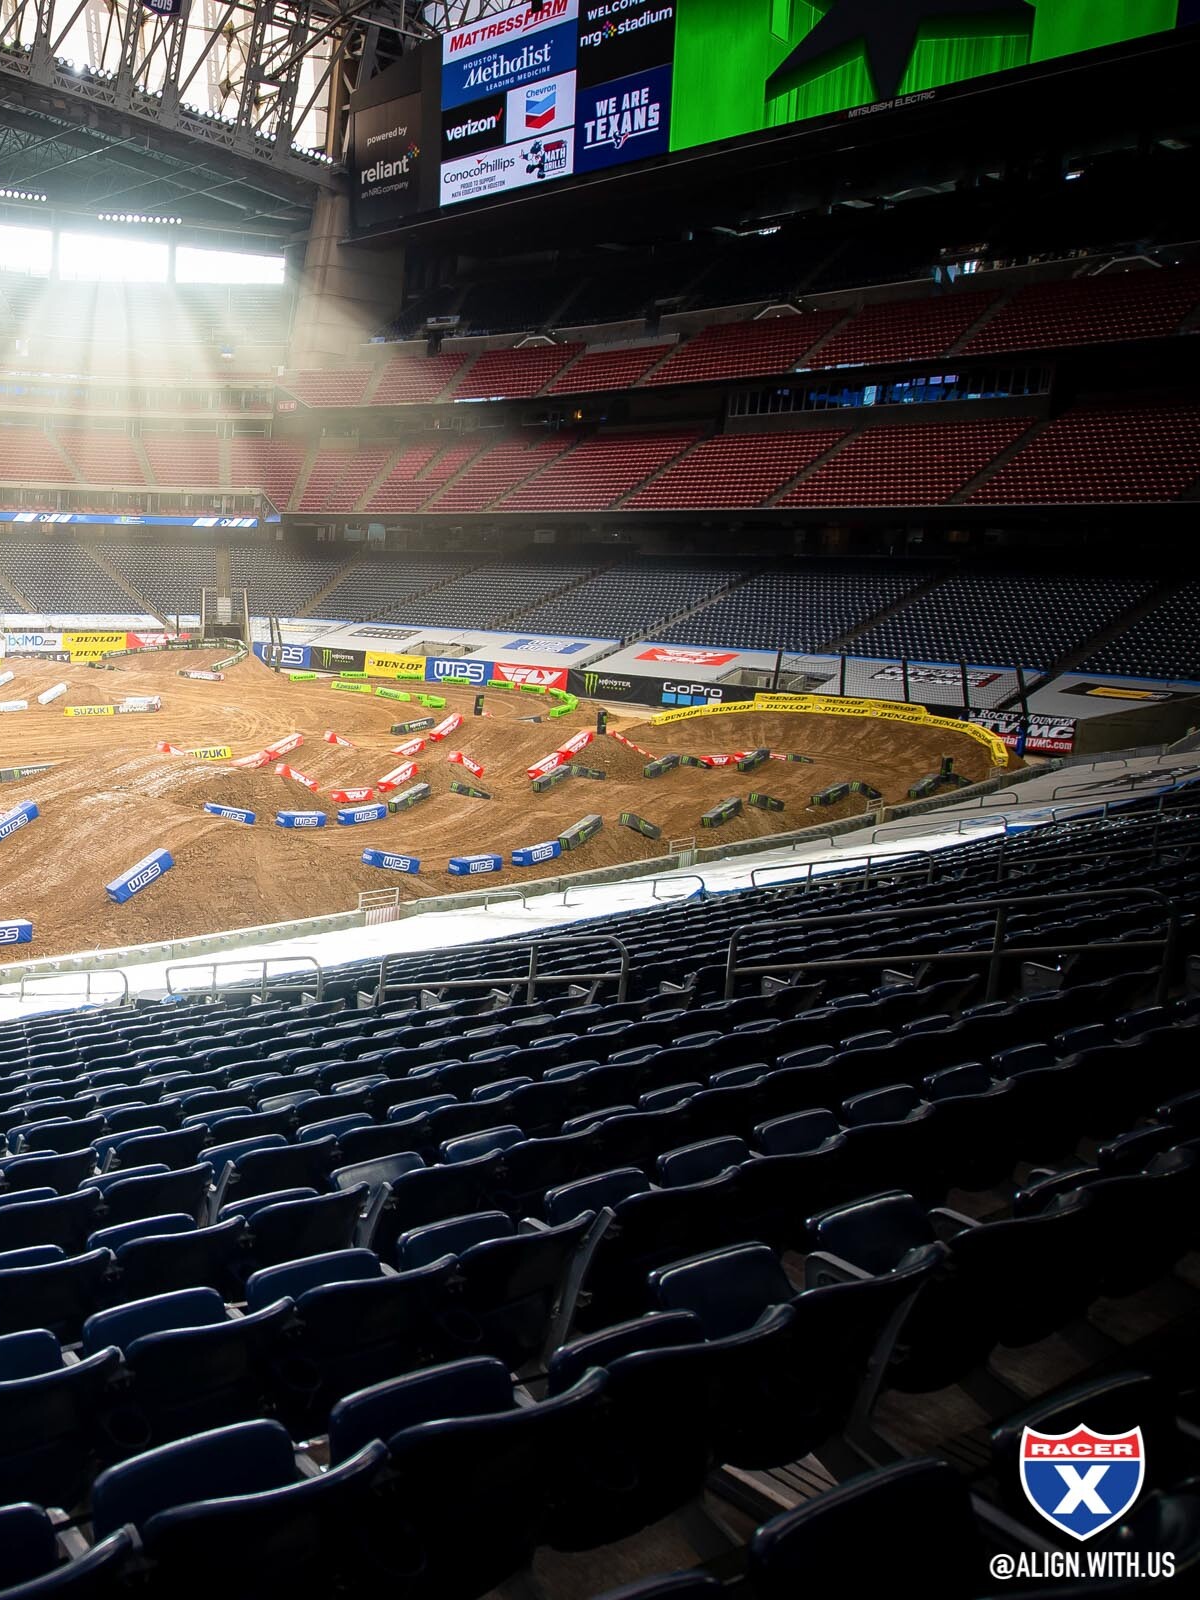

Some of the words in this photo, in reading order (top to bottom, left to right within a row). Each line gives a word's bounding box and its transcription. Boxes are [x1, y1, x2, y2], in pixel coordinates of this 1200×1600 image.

[587, 0, 646, 21] WELCOM
[580, 31, 602, 47] nrg
[617, 7, 673, 35] stadium
[463, 53, 498, 71] HOUSTON
[463, 43, 552, 89] Methodist
[486, 76, 515, 92] LEADING
[517, 65, 551, 82] MEDICINE
[525, 83, 557, 99] Chevron
[595, 97, 617, 118] WE
[621, 86, 650, 111] ARE
[848, 100, 893, 119] MITSUBISHI
[894, 90, 936, 107] ELECTRIC
[446, 114, 496, 141] verizon
[584, 103, 660, 144] TEXANS
[367, 129, 398, 147] powered
[360, 155, 410, 185] reliant
[443, 156, 515, 184] ConocoPhillips
[376, 660, 423, 671] DUNLOP
[433, 660, 484, 682] WPS
[599, 678, 631, 688] MONSTER
[662, 682, 723, 698] GoPro
[73, 707, 110, 715] SUZUKI
[712, 704, 753, 714] DUNLOP
[767, 703, 811, 711] DUNLOP
[823, 707, 869, 716] DUNLOP
[978, 709, 1021, 722] ROCKY
[665, 710, 699, 722] DUNLOP
[879, 713, 922, 723] DUNLOP
[931, 719, 969, 730] DUNLOP
[382, 856, 411, 870] WPS
[470, 859, 494, 873] WPS
[127, 862, 161, 893] WPS
